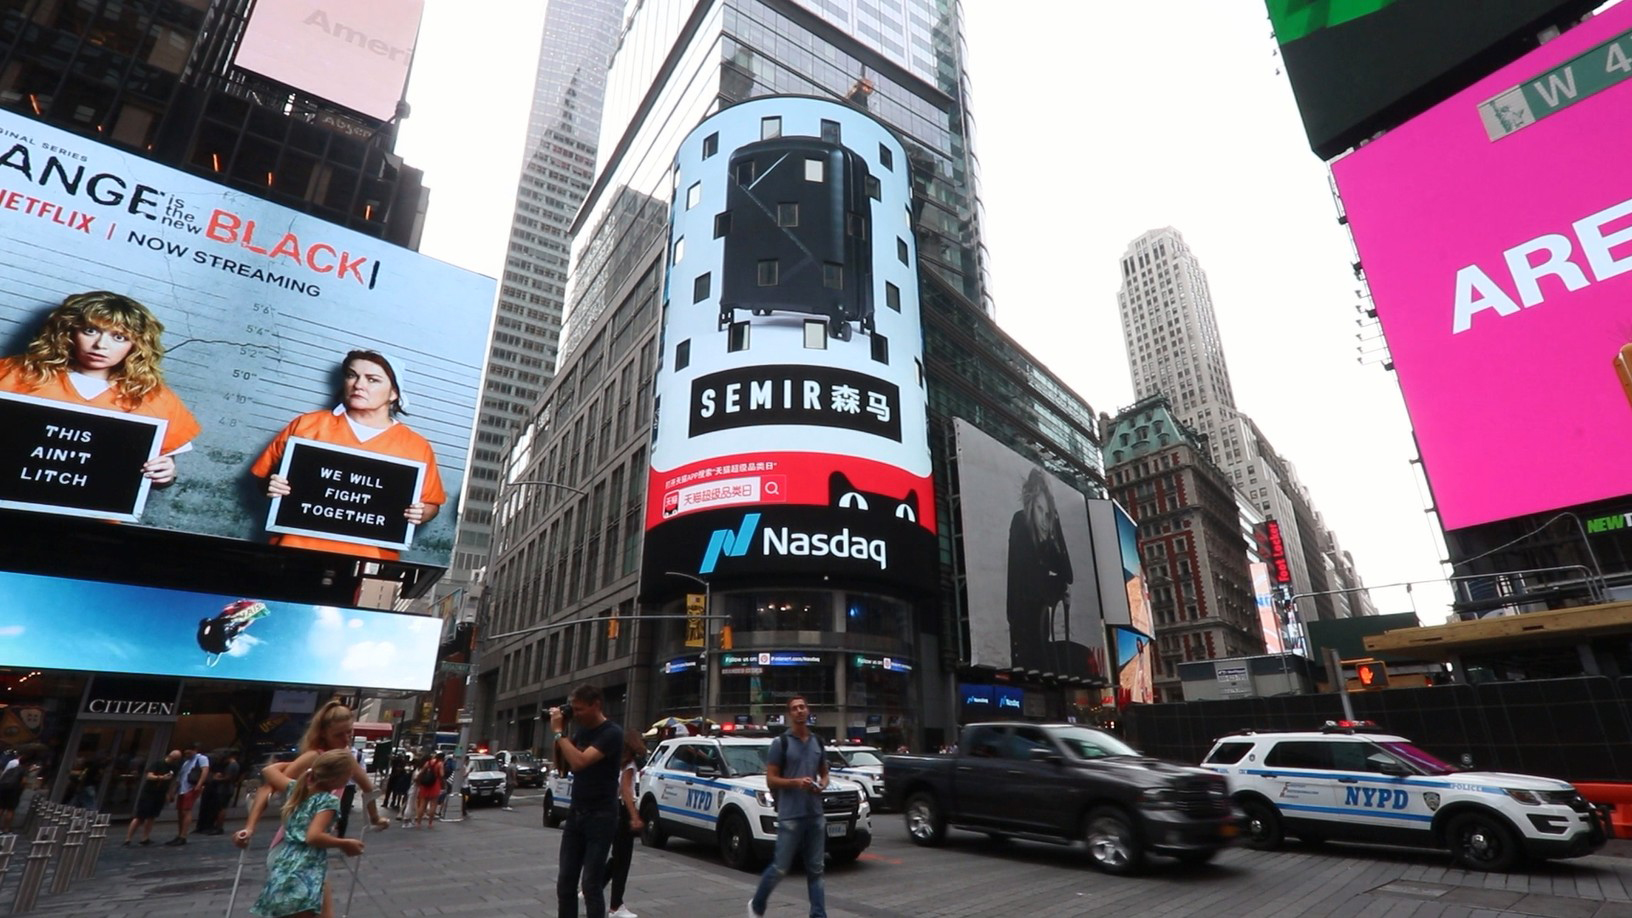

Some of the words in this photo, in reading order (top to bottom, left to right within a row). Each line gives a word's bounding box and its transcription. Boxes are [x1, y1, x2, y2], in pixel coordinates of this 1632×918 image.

[1533, 66, 1578, 108] W
[322, 116, 373, 138] Absen
[42, 142, 88, 162] SERIES
[0, 143, 161, 221] ANGE
[167, 194, 185, 209] is
[164, 204, 195, 223] the
[161, 216, 202, 235] new
[205, 208, 367, 286] BLACK
[127, 230, 189, 258] NOW
[193, 250, 321, 297] STREAMING
[1452, 198, 1632, 335] ARE
[700, 379, 822, 418] SEMIR
[830, 383, 892, 423] 森马
[45, 424, 92, 443] THIS
[30, 446, 92, 464] AIN'T
[20, 466, 88, 487] LITCH
[320, 467, 343, 481] WE
[350, 472, 384, 489] WILL
[324, 487, 372, 504] FIGHT
[301, 502, 386, 526] TOGETHER
[763, 527, 887, 571] Nasdaq
[88, 698, 174, 716] CITIZEN
[1344, 785, 1409, 810] NYPD
[1450, 783, 1483, 792] POLICE
[685, 787, 713, 812] NYPD
